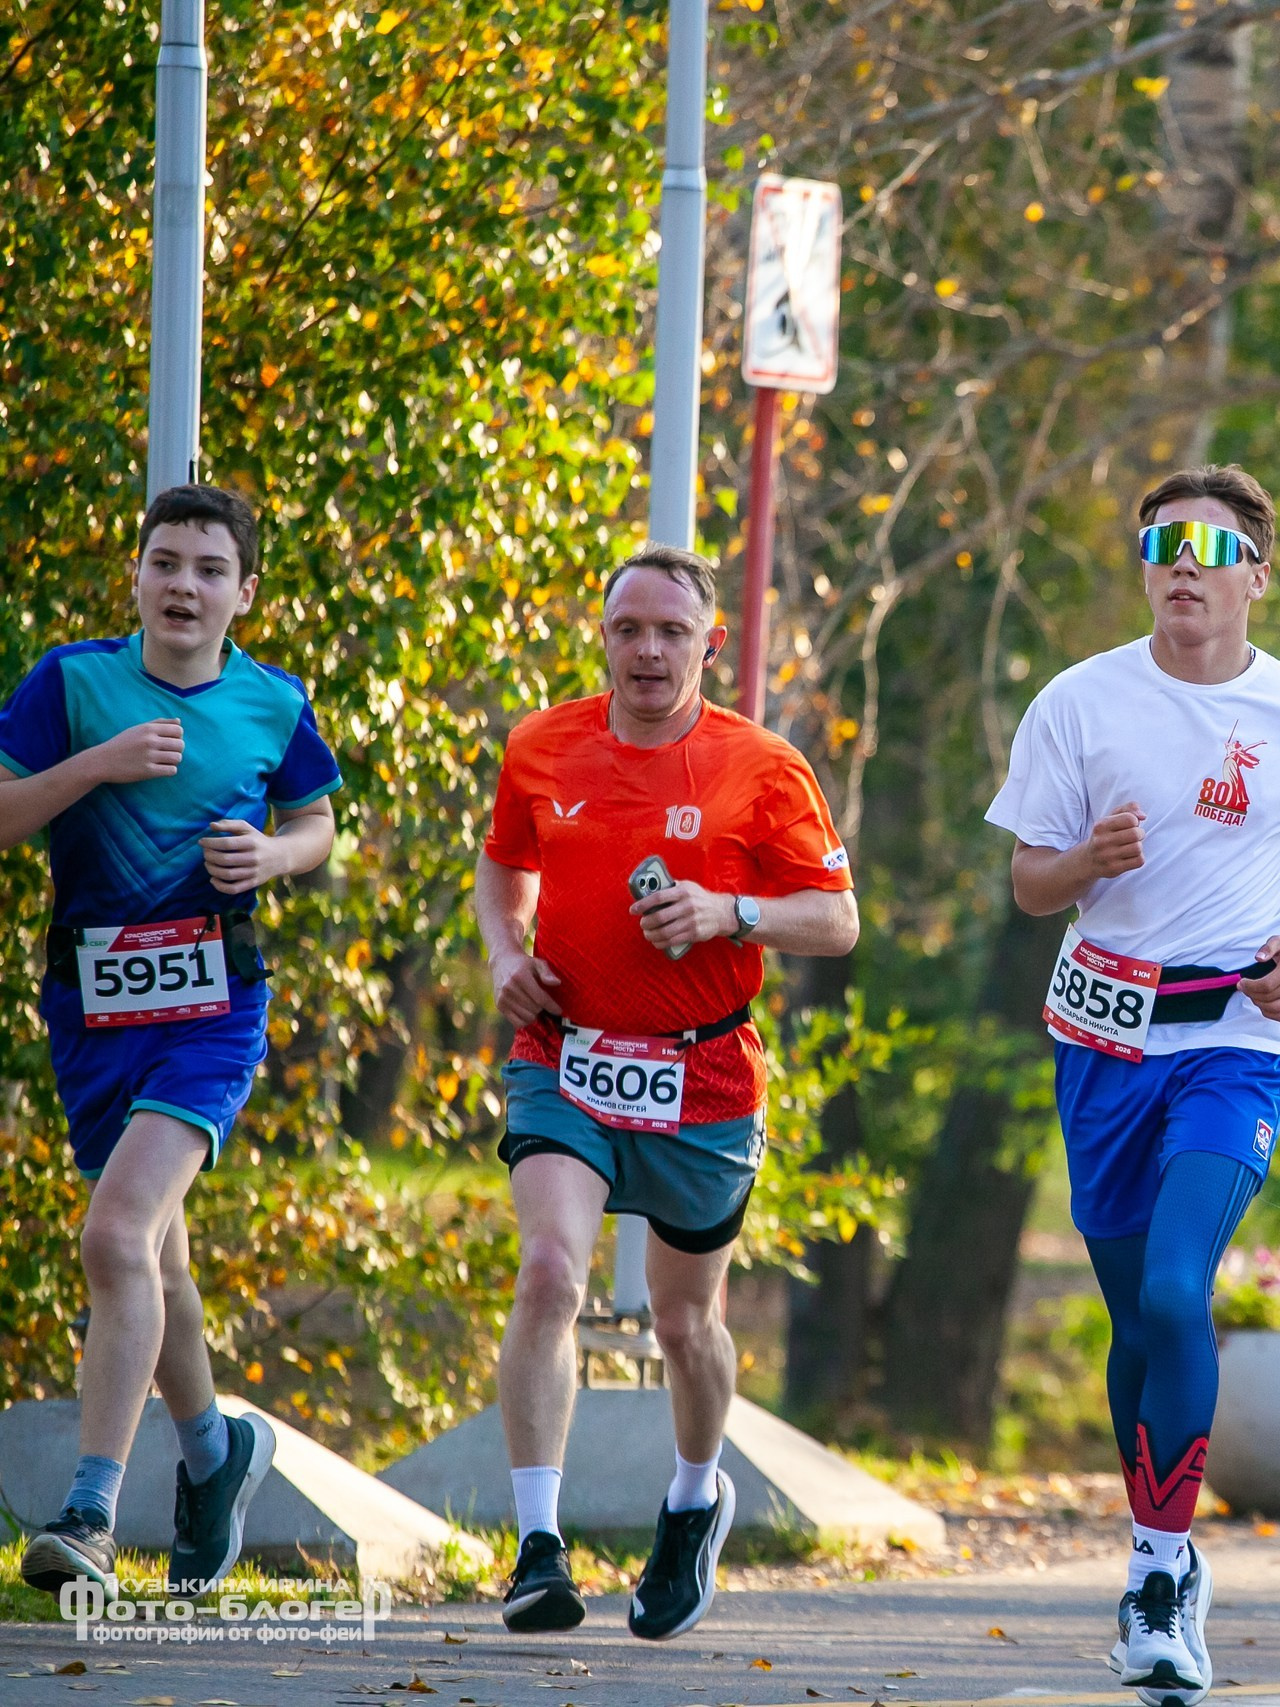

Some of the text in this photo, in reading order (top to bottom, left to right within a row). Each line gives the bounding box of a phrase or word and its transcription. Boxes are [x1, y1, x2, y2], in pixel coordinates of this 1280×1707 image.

[1200, 778, 1230, 804] 80
[665, 805, 701, 839] 10
[1194, 803, 1246, 826] ПОБЕДА!
[124, 928, 177, 939] КРАСНОЯРСКИЕ
[1080, 946, 1118, 967] КРАСНОЯРСКИЕ
[1086, 956, 1105, 968] МОСТЫ
[94, 949, 215, 998] 5951
[1052, 956, 1144, 1030] 5858
[1057, 1002, 1088, 1025] ЕЛИЗАРЬЕВ
[1088, 1021, 1119, 1036] НИКИТА
[602, 1039, 648, 1049] КРАСНОЯРСКИЕ
[613, 1045, 635, 1053] МОСТЫ
[1115, 1045, 1131, 1054] 2026
[564, 1054, 678, 1105] 5606
[586, 1095, 617, 1109] ХРАМОВ
[617, 1104, 647, 1113] СЕРГЕЙ
